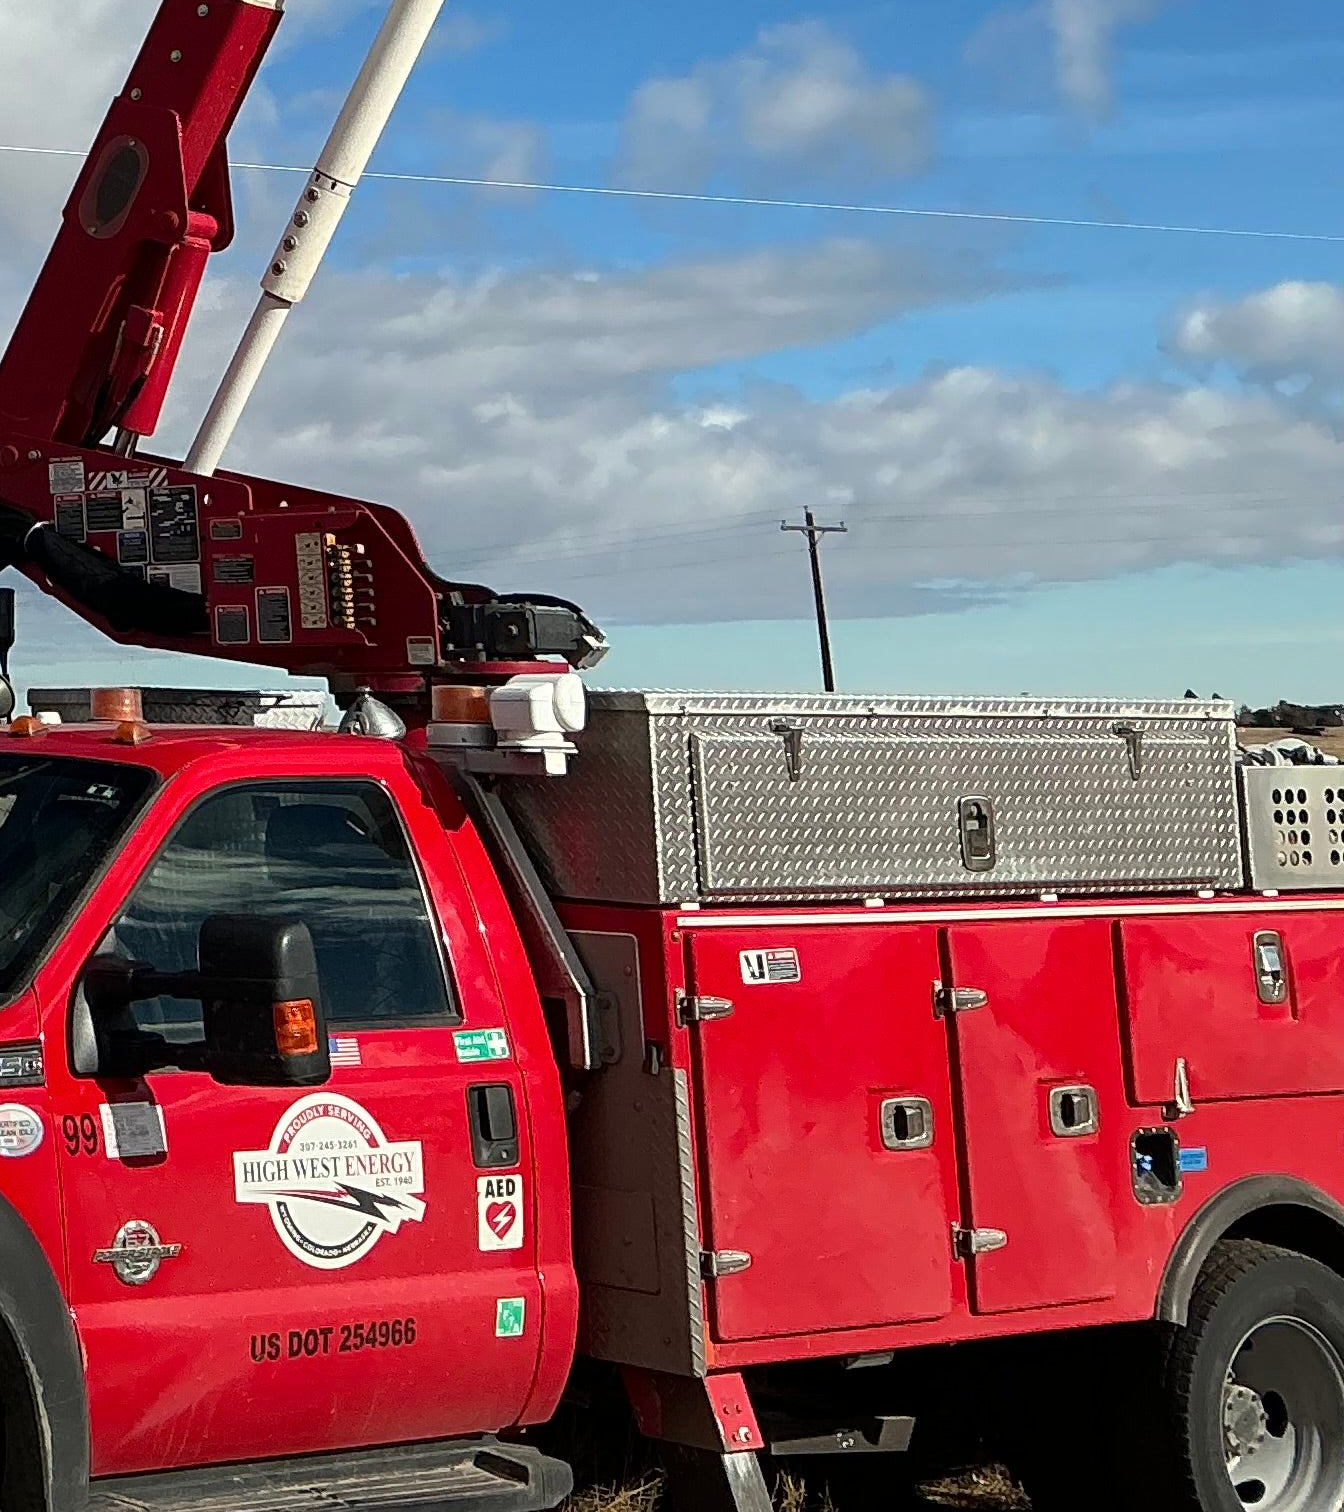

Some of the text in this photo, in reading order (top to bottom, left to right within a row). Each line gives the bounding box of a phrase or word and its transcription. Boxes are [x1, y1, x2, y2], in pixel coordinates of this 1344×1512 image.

[62, 1112, 98, 1157] 99
[282, 1104, 372, 1144] PROUDLY SERVING
[242, 1151, 415, 1183] HIGH WEST ENERGY
[375, 1177, 392, 1188] EST.
[484, 1178, 516, 1199] AED
[249, 1317, 417, 1362] US DOT 254966
